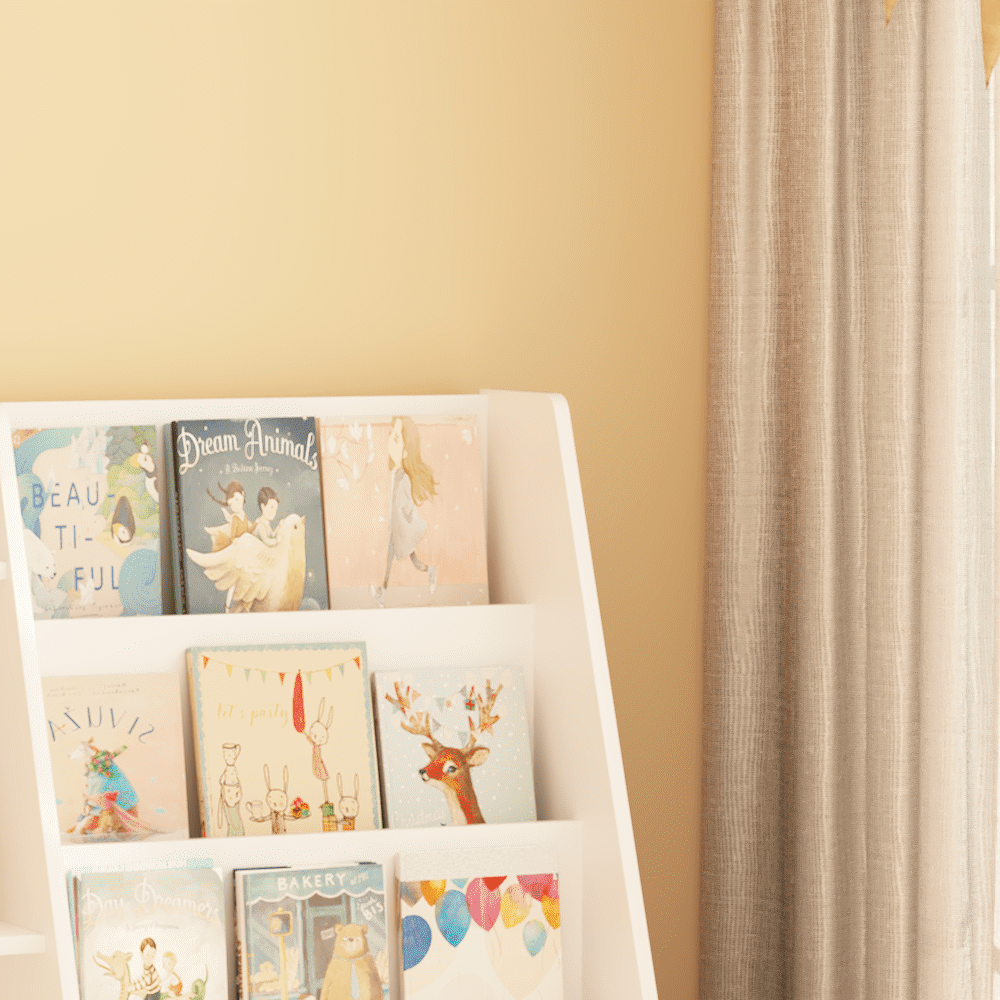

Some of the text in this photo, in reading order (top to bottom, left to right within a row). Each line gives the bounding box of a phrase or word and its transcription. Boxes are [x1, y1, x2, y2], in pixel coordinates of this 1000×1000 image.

[177, 417, 319, 475] Dream Animals
[32, 482, 115, 508] BEAU-
[55, 525, 93, 549] TI-
[74, 566, 119, 591] FUL
[277, 873, 347, 891] BAKERY
